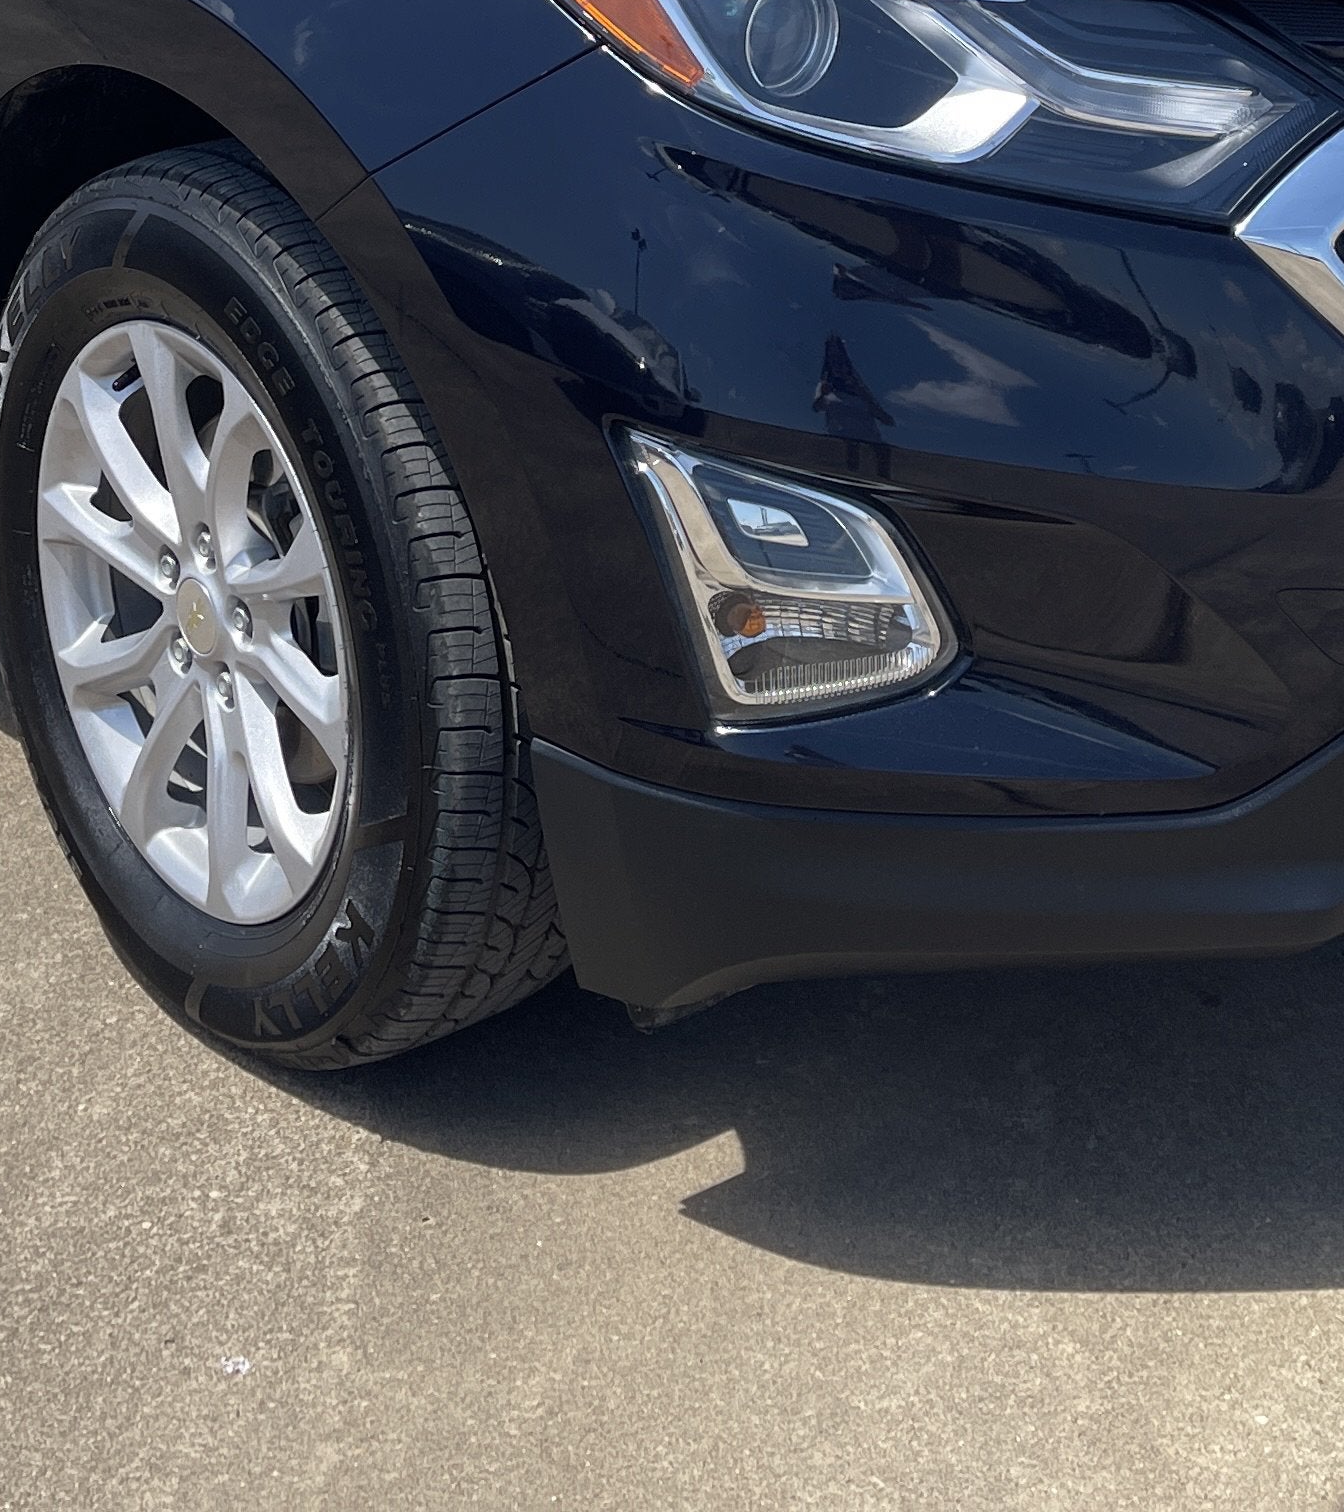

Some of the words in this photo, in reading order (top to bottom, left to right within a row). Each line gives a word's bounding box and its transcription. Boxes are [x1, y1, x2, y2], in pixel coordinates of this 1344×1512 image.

[223, 295, 296, 398] EDGE
[299, 418, 378, 633] TOURING
[252, 898, 376, 1038] KELLY
